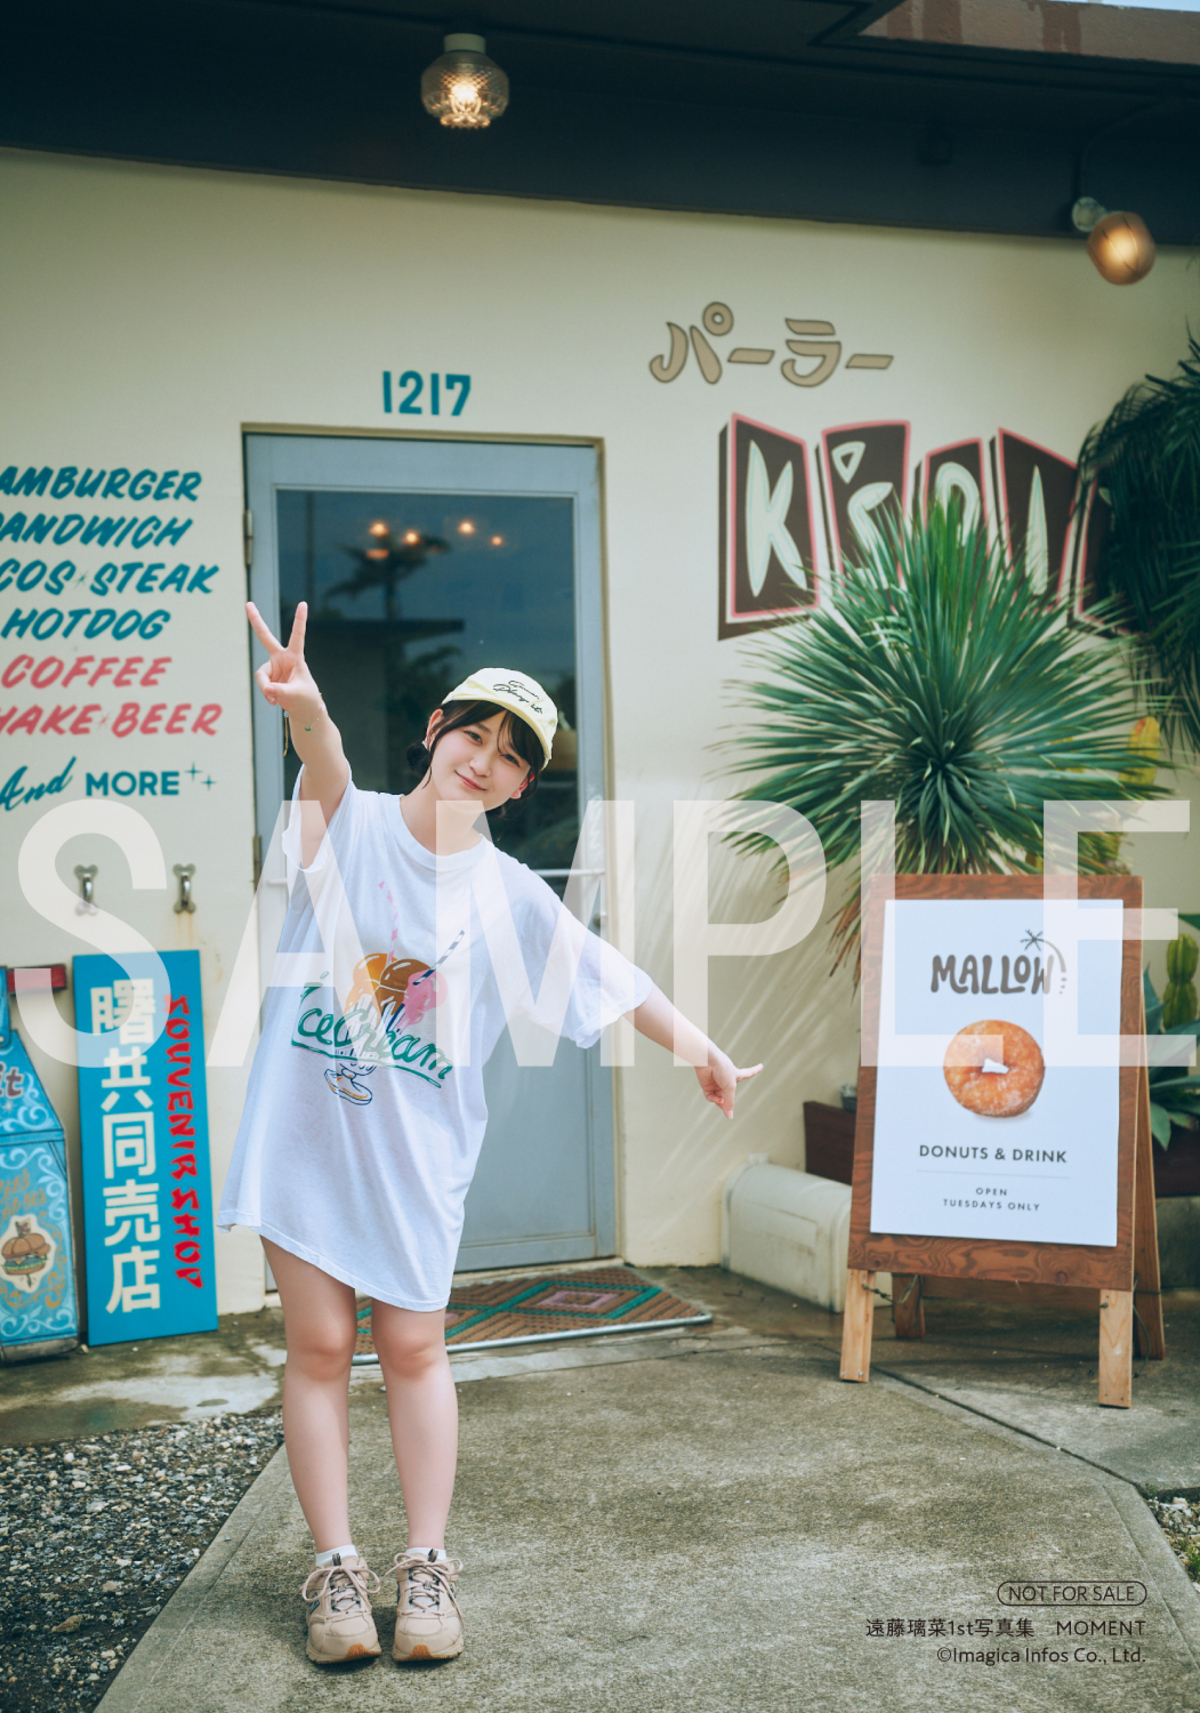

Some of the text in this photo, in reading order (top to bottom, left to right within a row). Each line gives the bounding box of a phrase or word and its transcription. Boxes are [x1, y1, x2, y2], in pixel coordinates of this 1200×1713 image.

[649, 301, 894, 388] パーラー
[382, 370, 471, 417] 1217
[0, 511, 194, 549] ANDWICH
[89, 561, 219, 597] STEAK
[0, 607, 171, 641] HOTDOG
[0, 653, 173, 689] COFFEE
[110, 702, 223, 739] BEER
[0, 755, 180, 812] And MORE
[930, 954, 1055, 995] MALLOW
[162, 992, 204, 1290] SOUVENIR SHOP
[919, 1144, 1068, 1163] DONUTS & DRINK
[942, 1198, 1041, 1212] TUESDAYS ONLY
[975, 1187, 1008, 1197] OPEN
